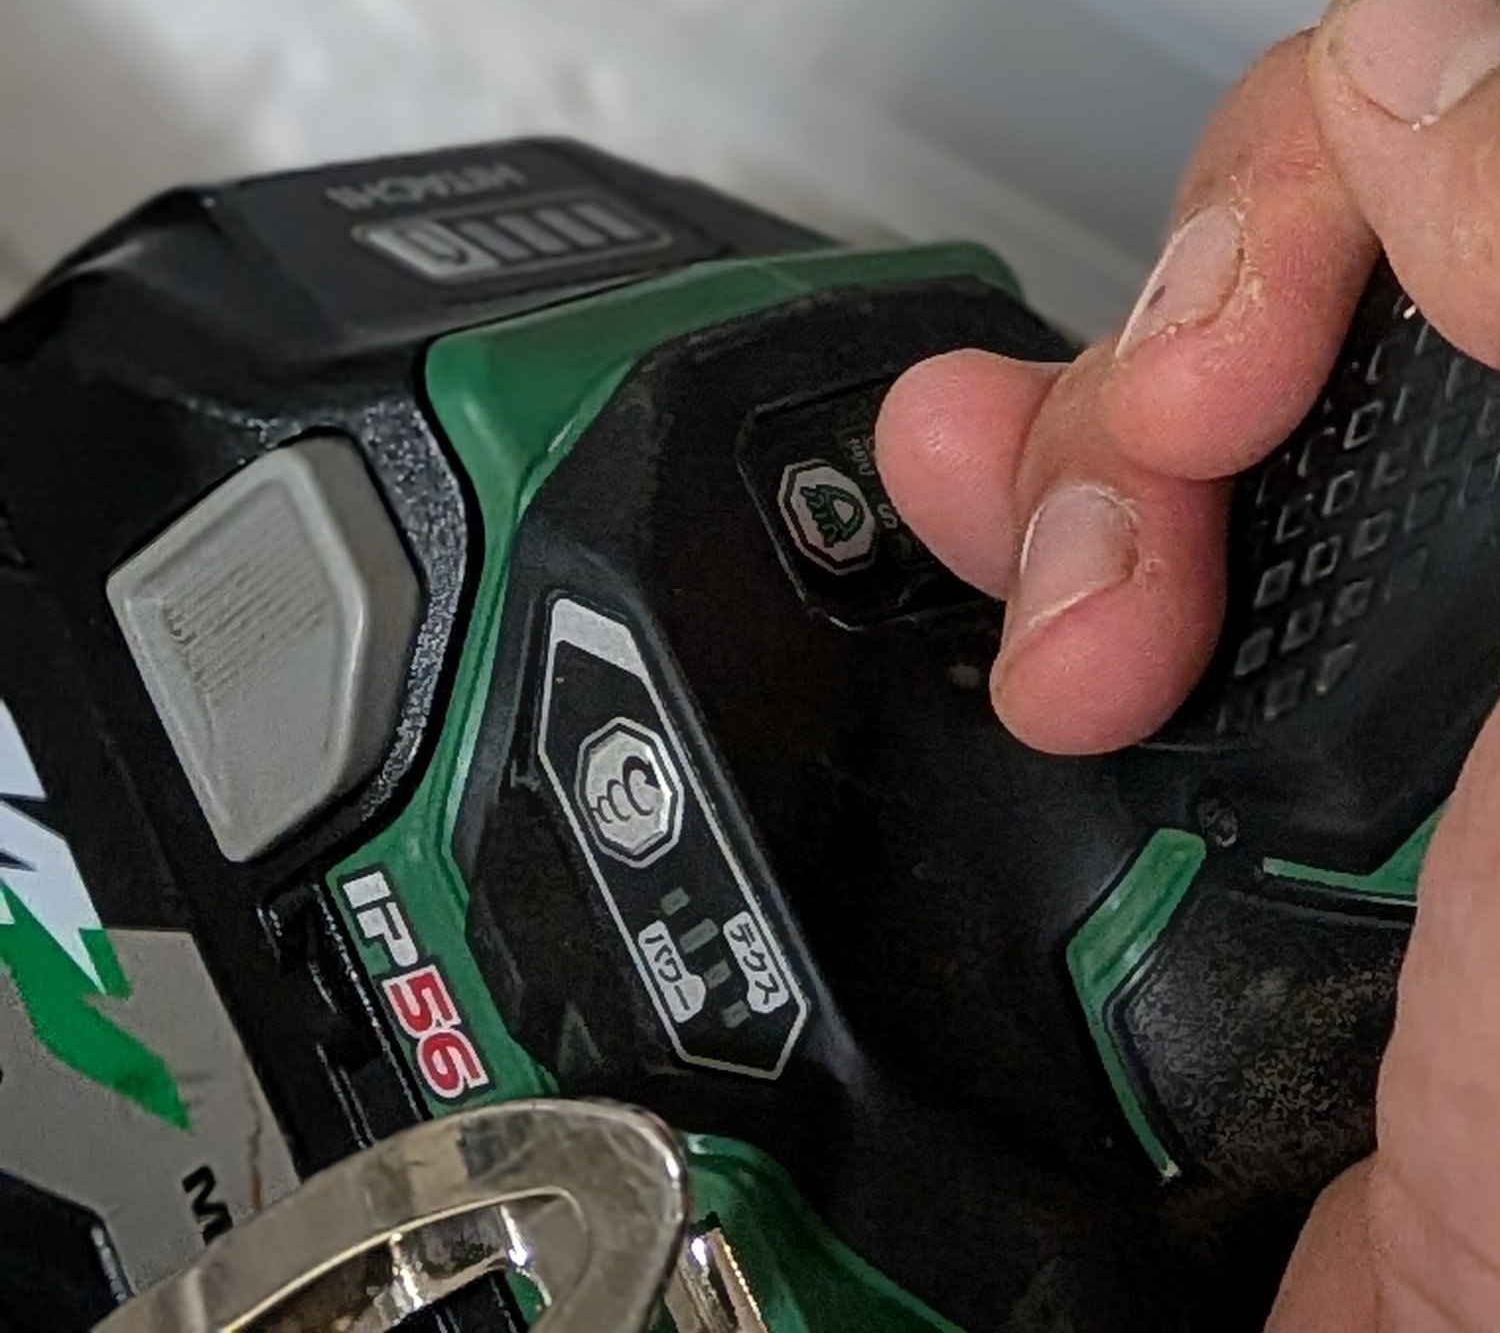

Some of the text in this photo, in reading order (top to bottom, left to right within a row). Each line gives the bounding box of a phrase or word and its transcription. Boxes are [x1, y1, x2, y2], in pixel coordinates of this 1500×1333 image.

[341, 869, 490, 1099] IP56
[643, 931, 692, 1013] パワー
